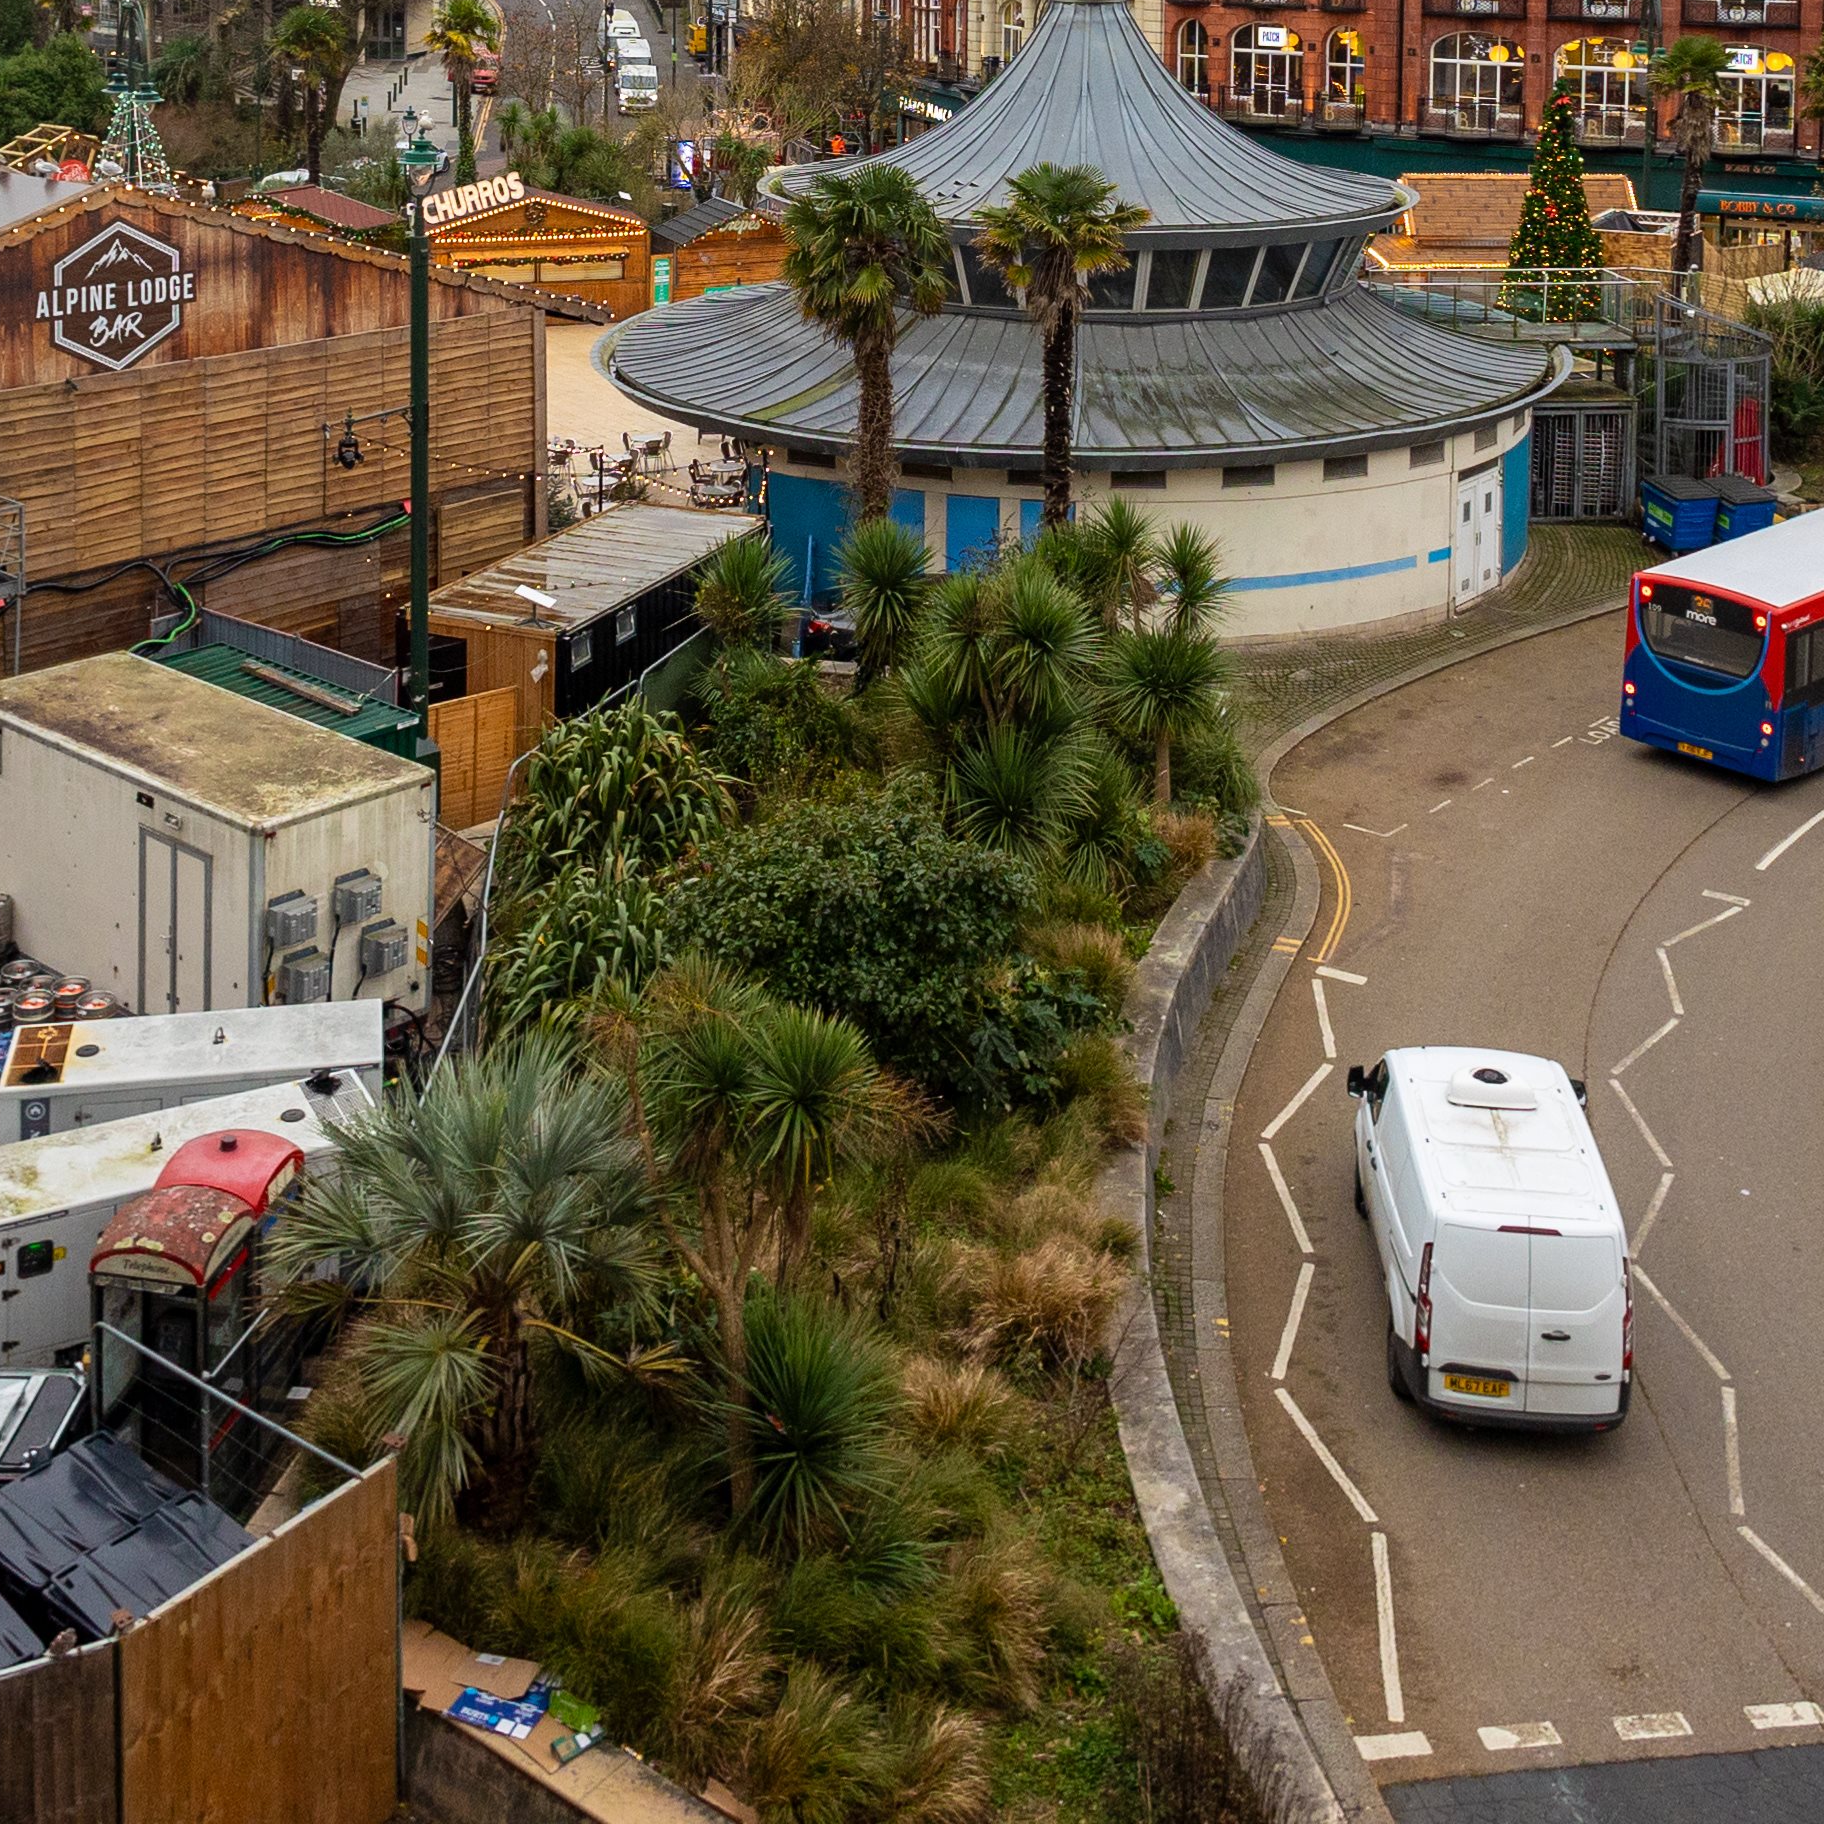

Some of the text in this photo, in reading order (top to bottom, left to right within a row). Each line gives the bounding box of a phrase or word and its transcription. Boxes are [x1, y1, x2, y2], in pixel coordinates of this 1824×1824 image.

[1262, 31, 1280, 42] PATCH
[1734, 53, 1753, 65] ATCH
[422, 171, 525, 224] CHURROS
[1719, 199, 1760, 213] BOBBY
[1762, 202, 1773, 213] &
[719, 219, 761, 235] repes
[36, 273, 194, 319] ALPINE LODGE
[89, 311, 146, 347] BAR
[1686, 609, 1717, 627] more
[123, 1259, 172, 1274] Telephone
